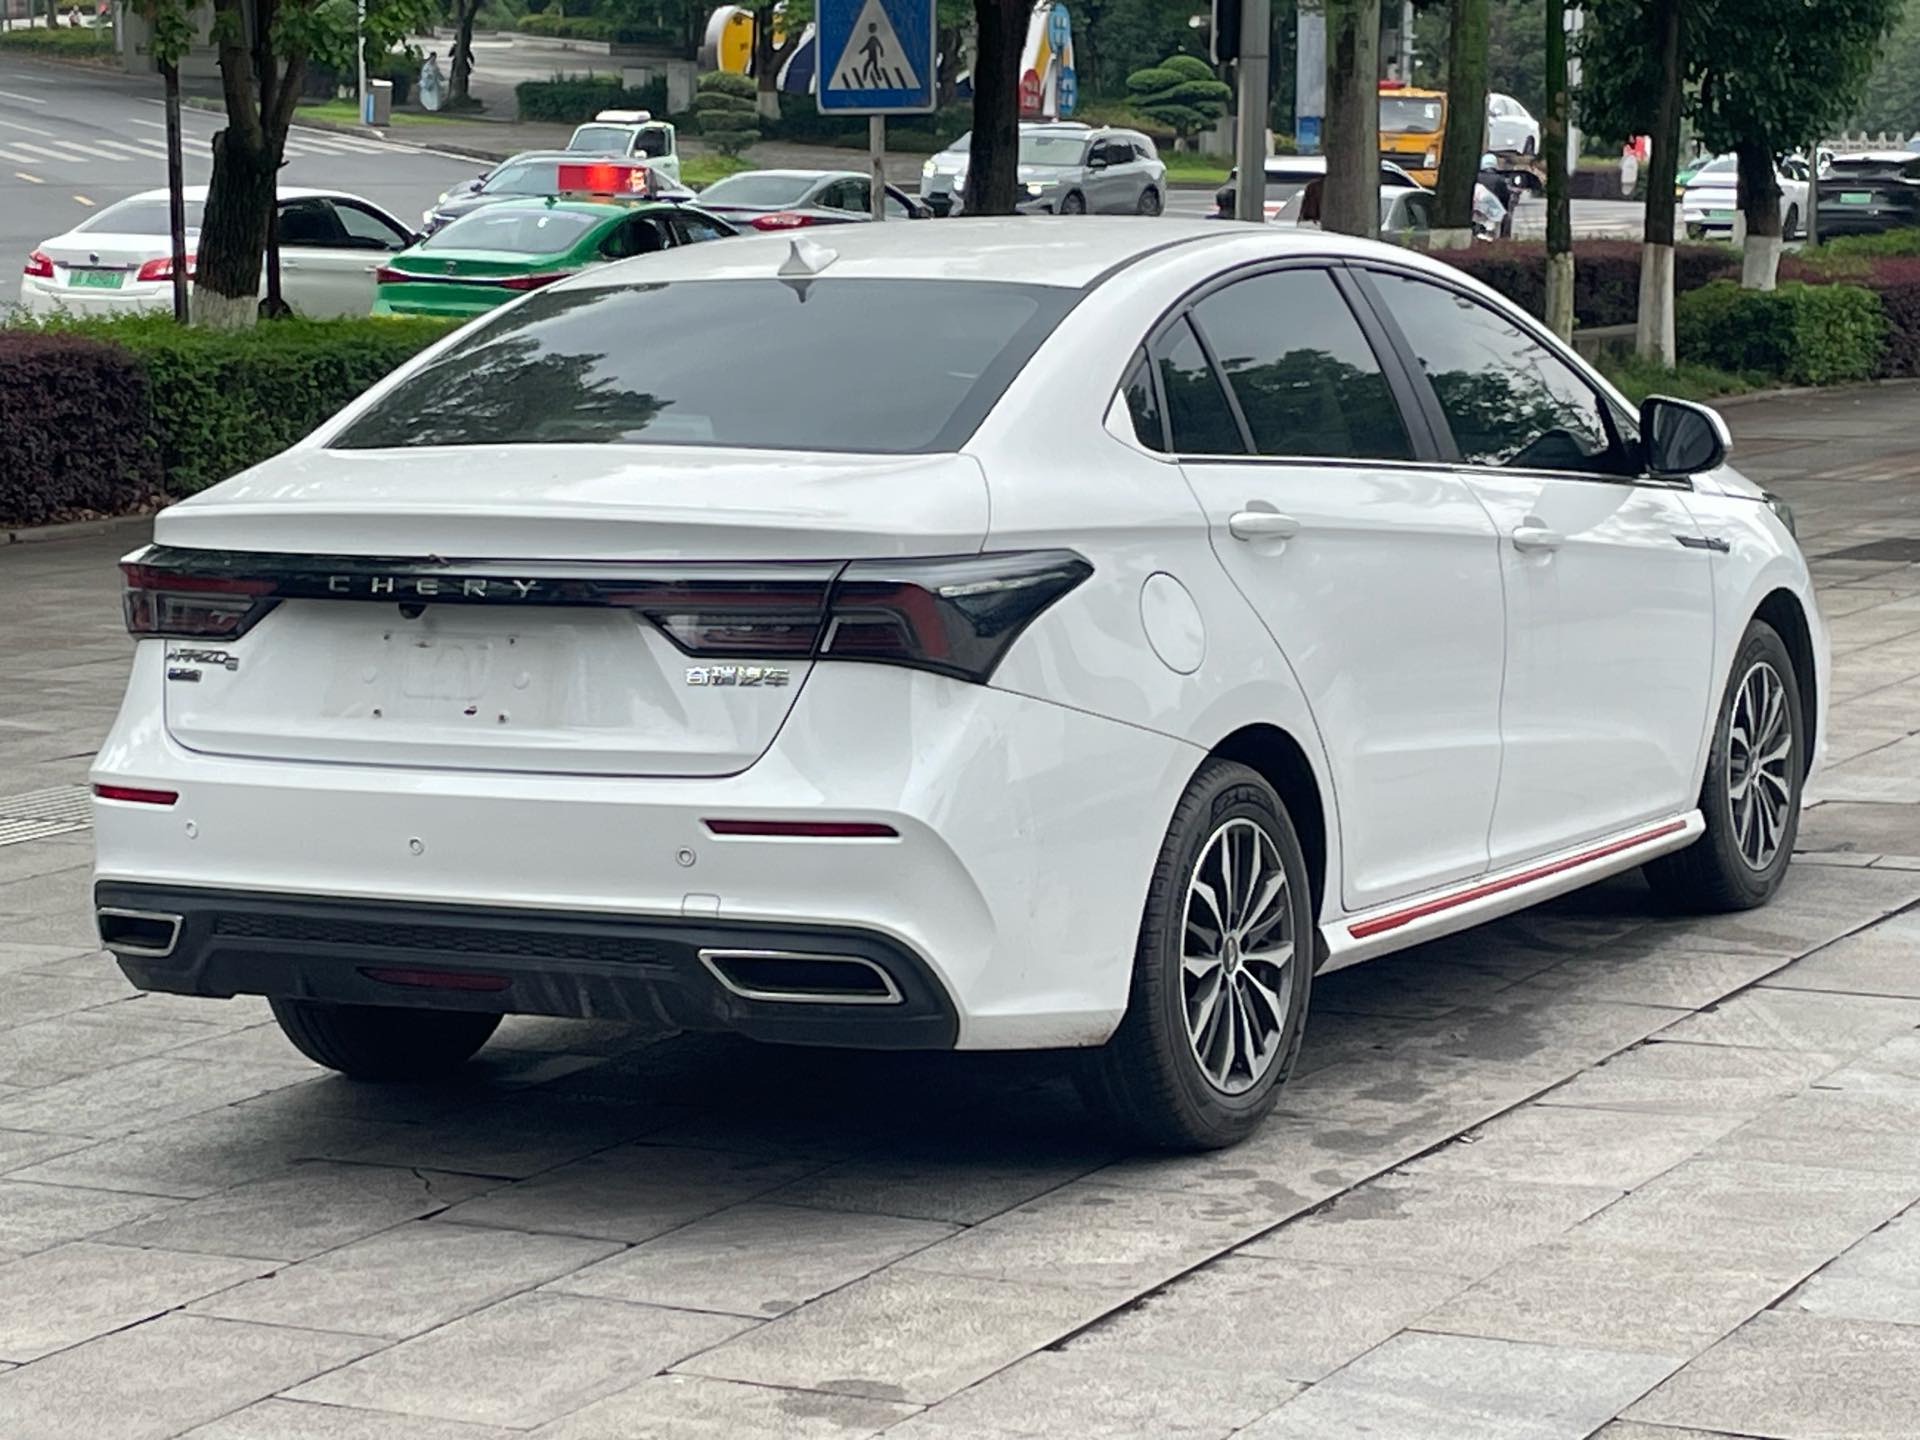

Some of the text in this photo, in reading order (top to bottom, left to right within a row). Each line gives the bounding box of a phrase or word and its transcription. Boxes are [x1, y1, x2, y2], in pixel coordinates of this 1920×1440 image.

[328, 575, 537, 598] CHERY
[685, 665, 790, 687] 奇瑞汽车
